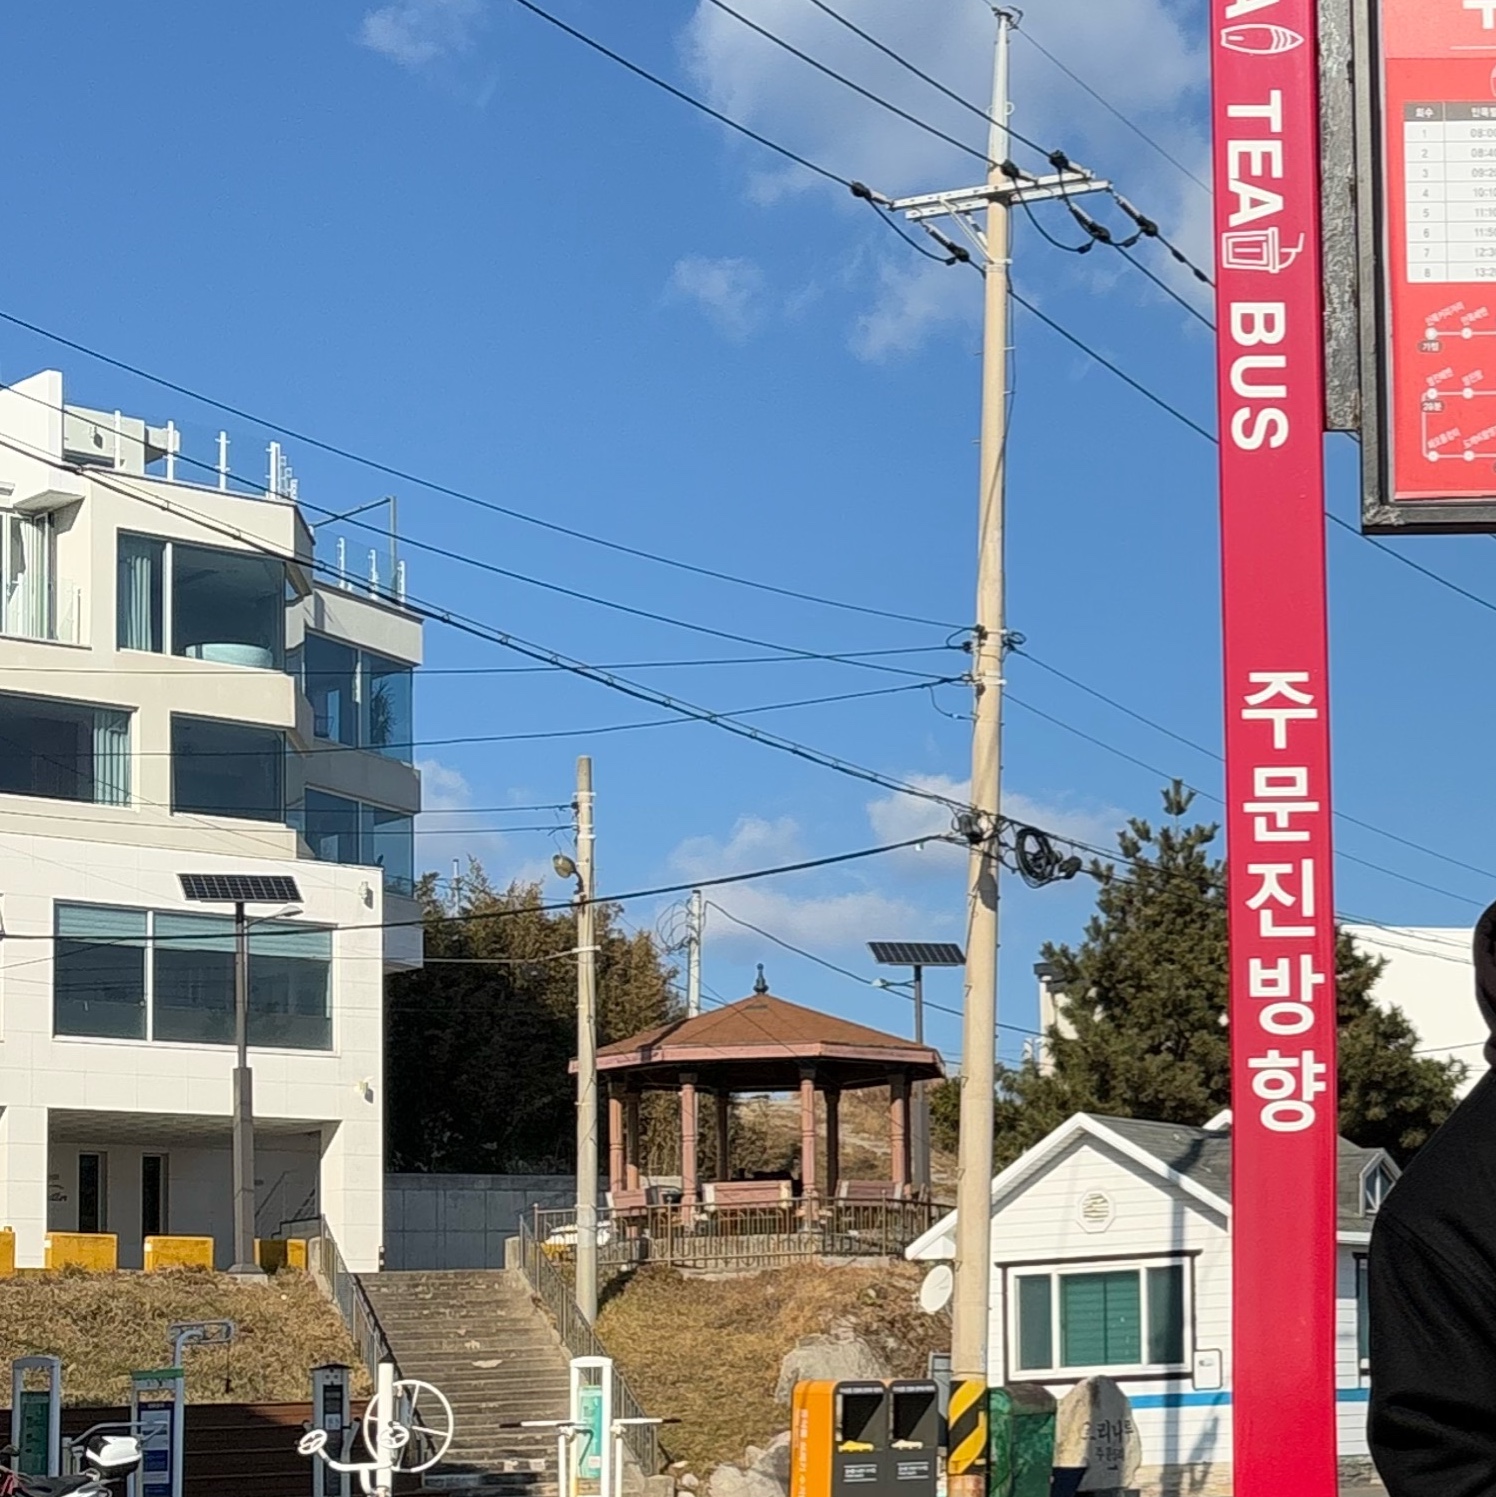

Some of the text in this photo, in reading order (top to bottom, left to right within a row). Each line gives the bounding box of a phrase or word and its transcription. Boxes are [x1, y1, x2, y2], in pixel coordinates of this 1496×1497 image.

[1227, 89, 1284, 226] TEA
[1230, 302, 1289, 450] BUS
[1241, 671, 1327, 1132] 주문진방향
